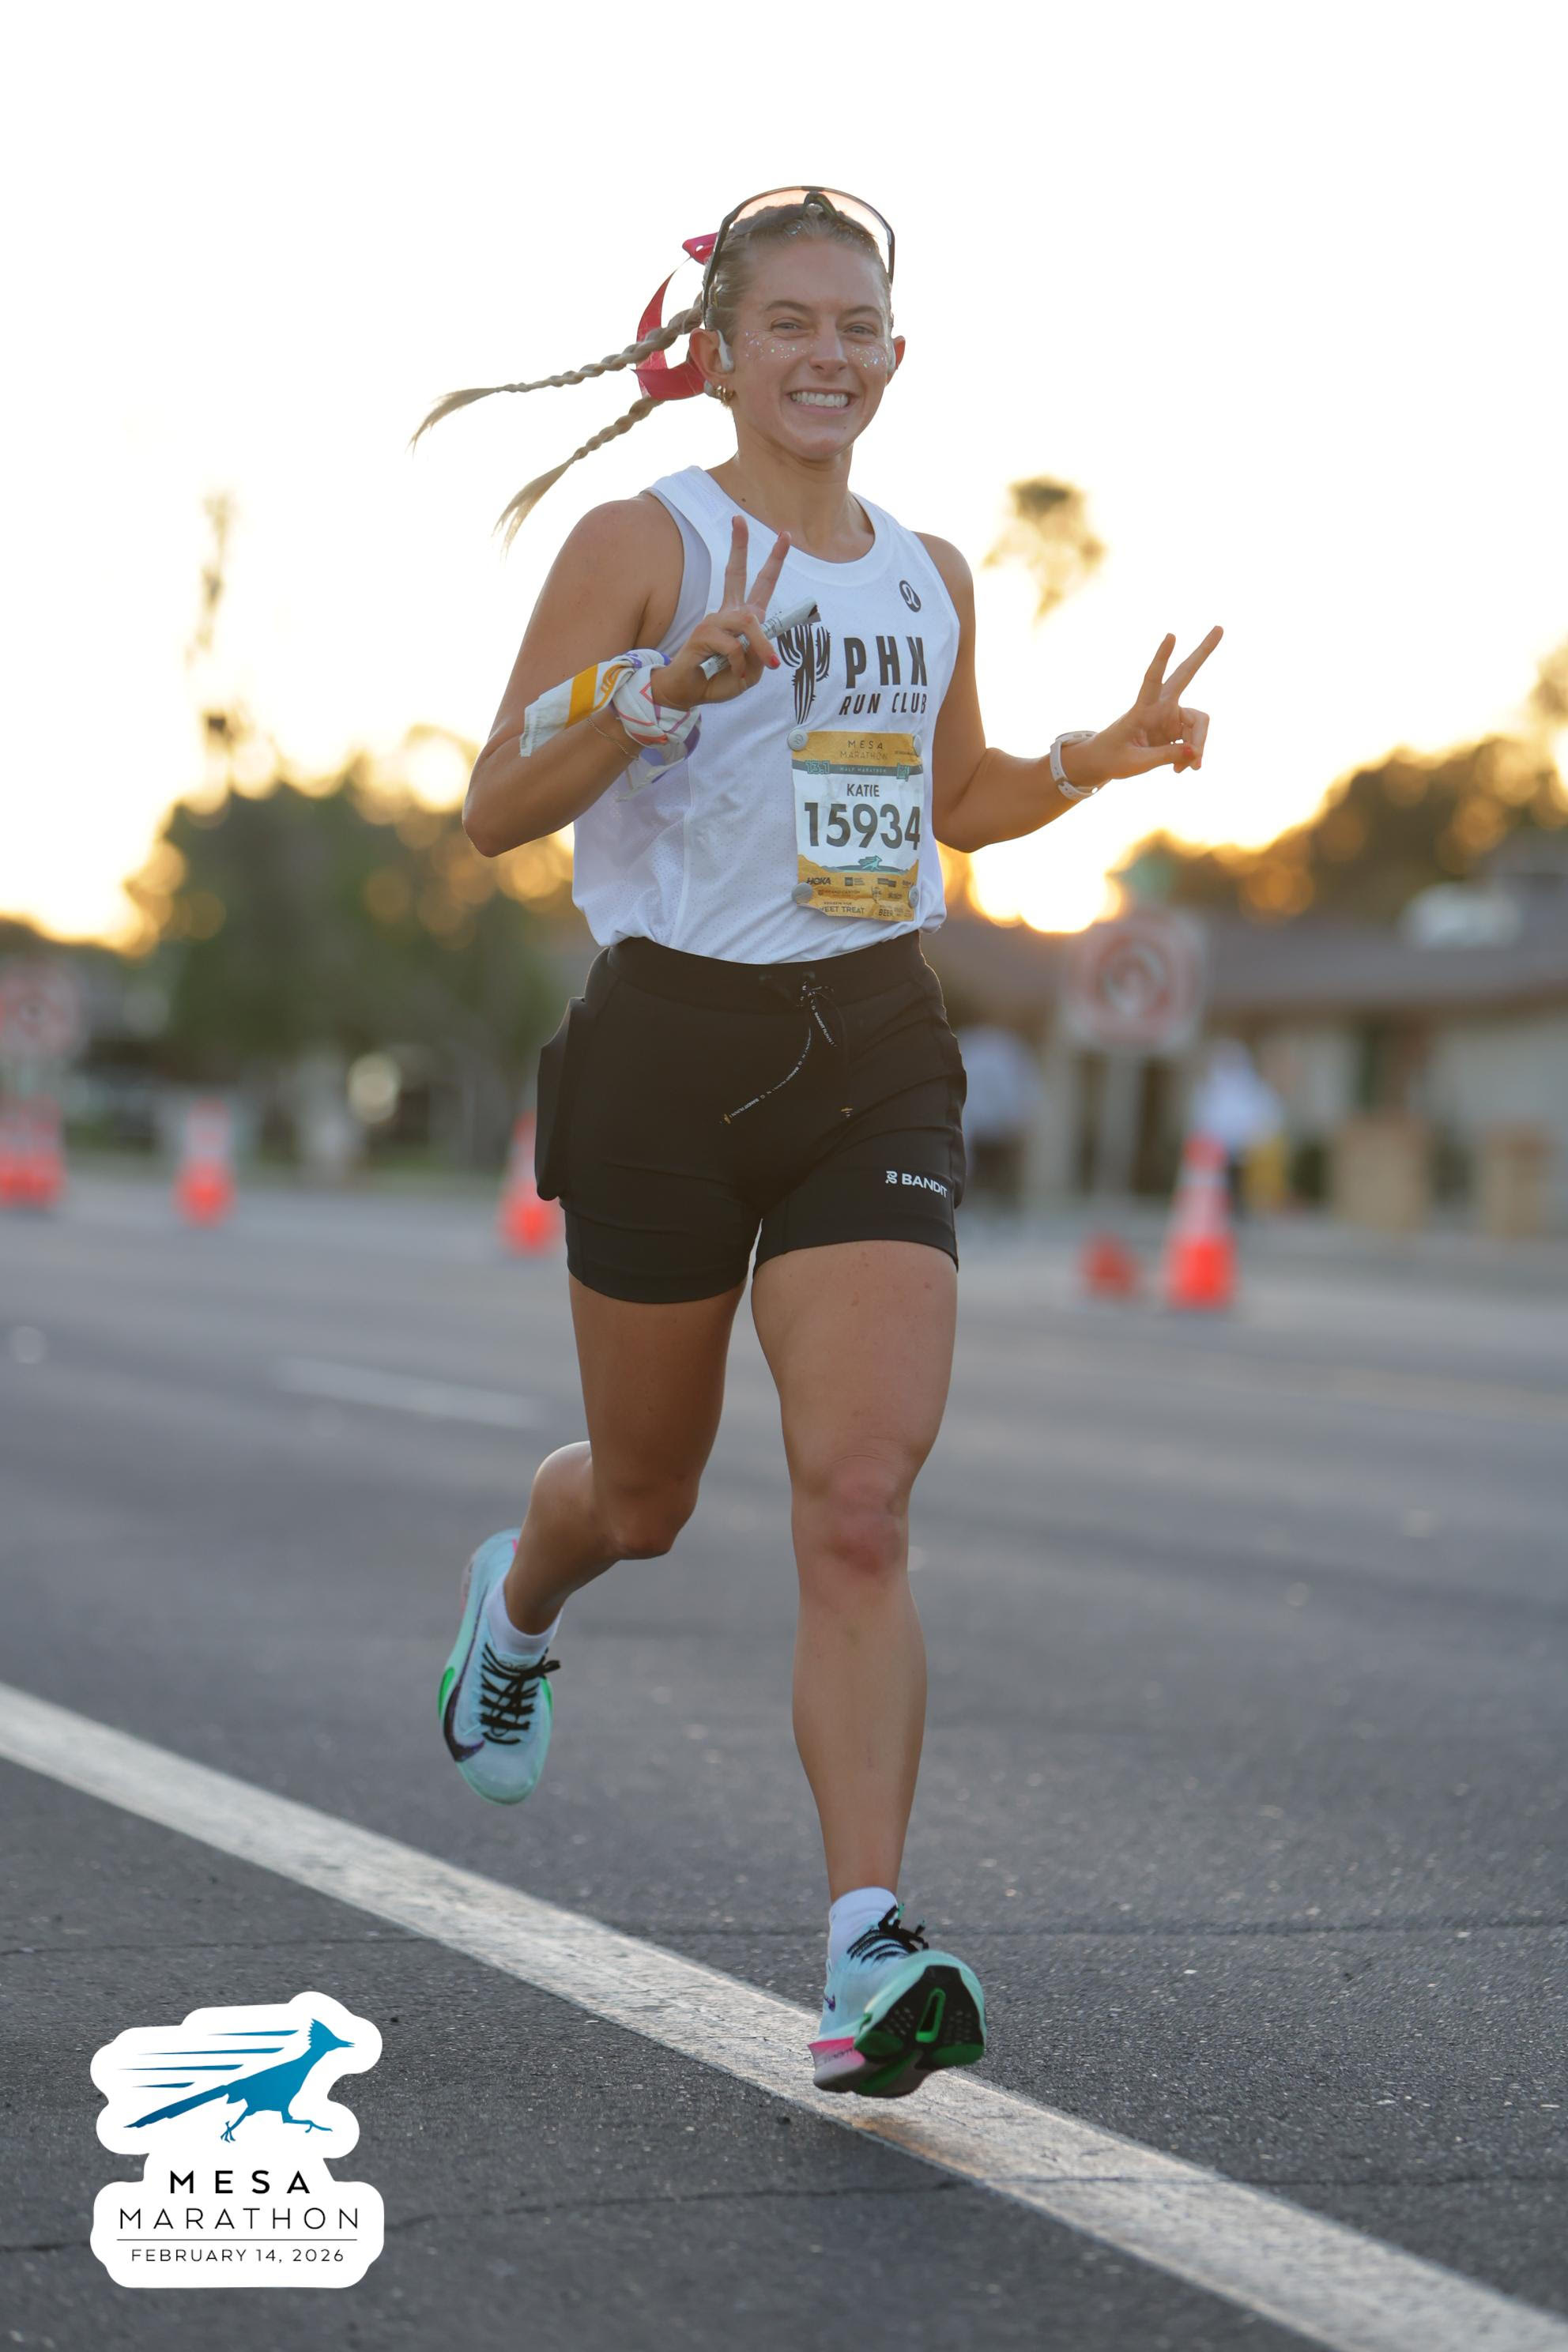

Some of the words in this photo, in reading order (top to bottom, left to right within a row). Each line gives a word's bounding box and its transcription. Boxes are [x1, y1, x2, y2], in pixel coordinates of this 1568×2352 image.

[843, 635, 928, 689] PHX
[839, 693, 881, 715] RUN
[891, 692, 927, 714] CLUB
[847, 740, 884, 749] MESA
[840, 751, 888, 760] MARATHON
[805, 760, 831, 775] 13.1
[846, 783, 880, 797] KATIE
[805, 802, 920, 850] 15934
[902, 1173, 948, 1198] BANDIT
